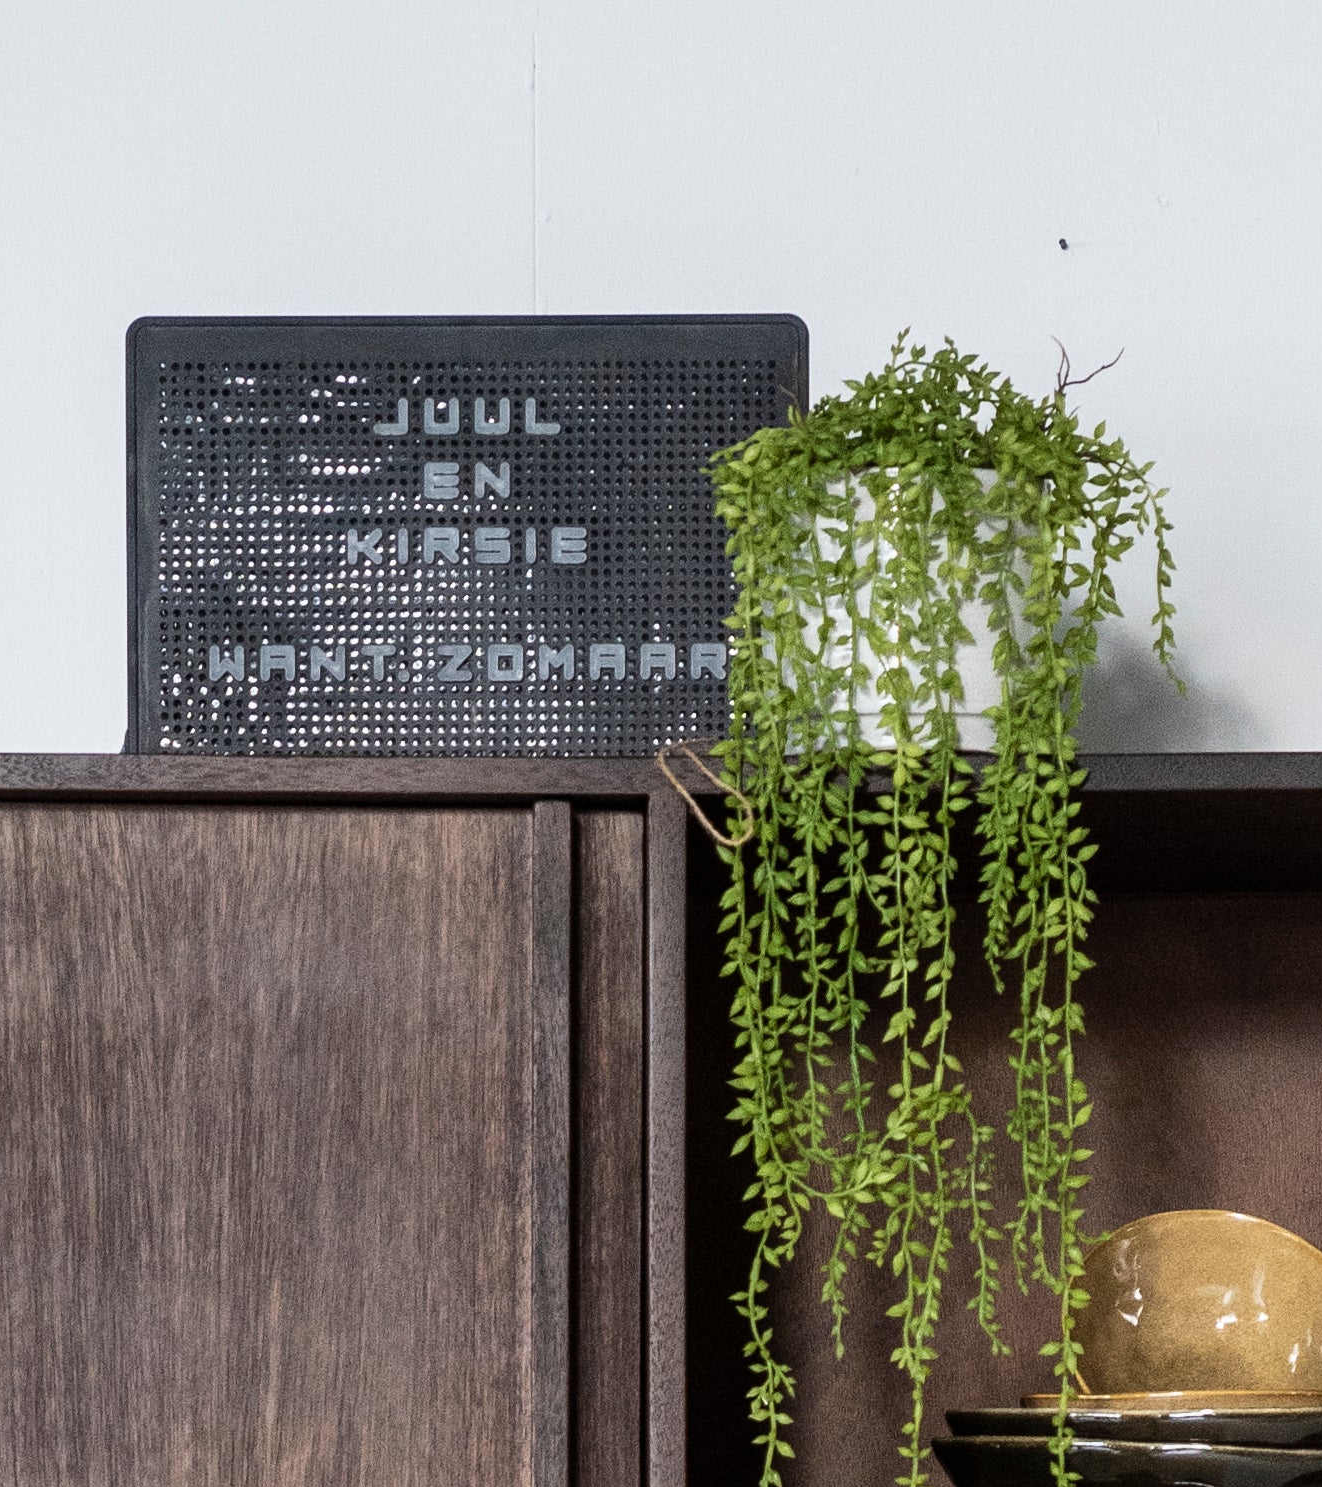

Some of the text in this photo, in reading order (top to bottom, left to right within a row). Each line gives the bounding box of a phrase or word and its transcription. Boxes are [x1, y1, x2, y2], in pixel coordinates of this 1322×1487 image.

[373, 397, 561, 436] JUUL
[424, 461, 511, 500] EN
[347, 526, 588, 565] KIRSIE
[436, 643, 728, 683] ZOMAAR
